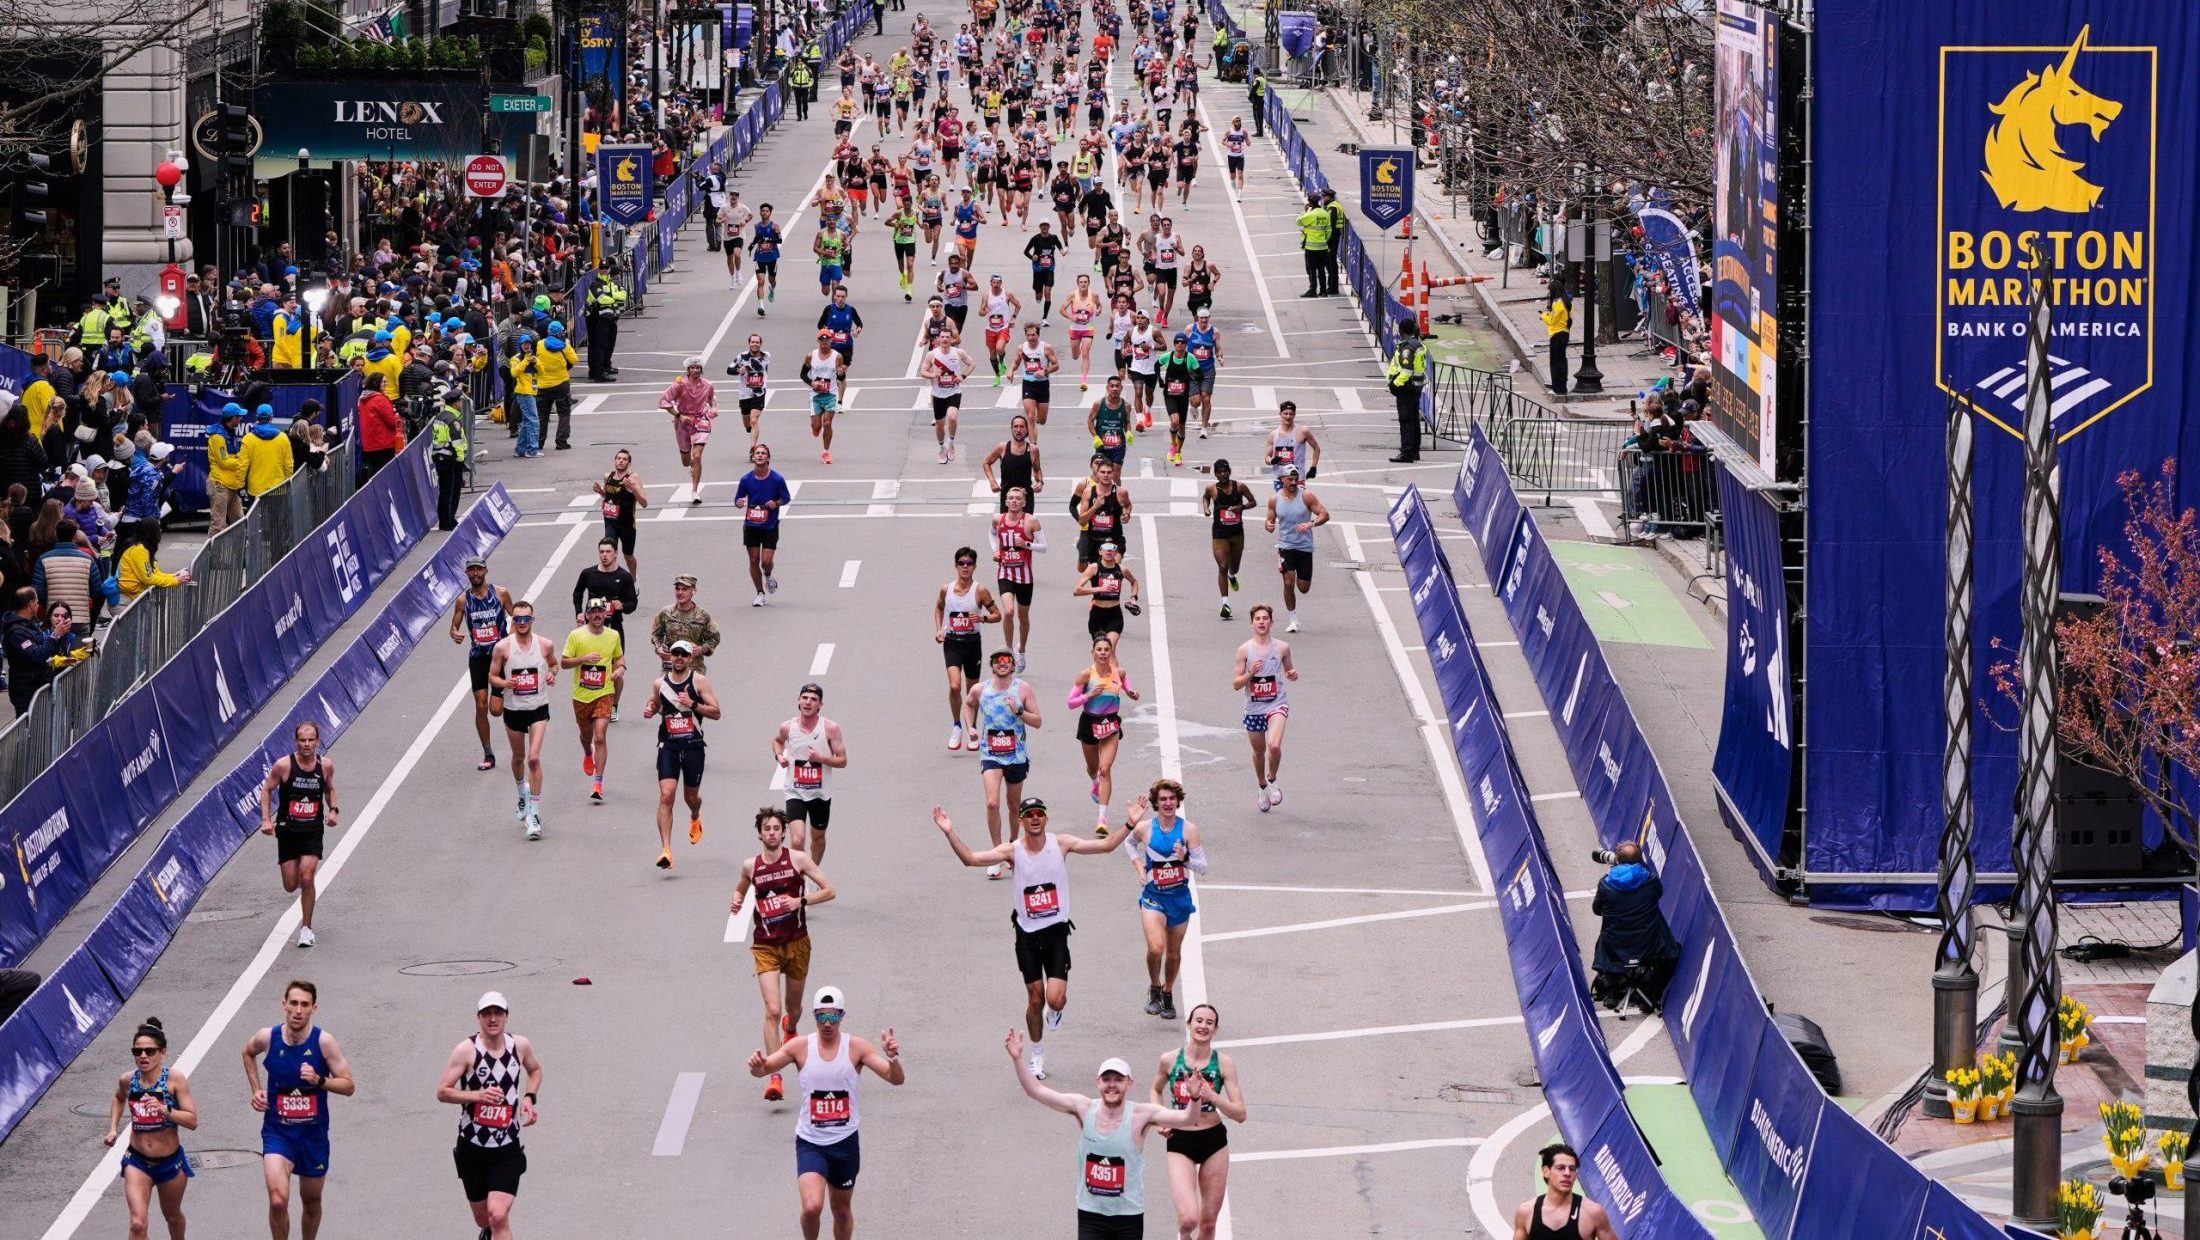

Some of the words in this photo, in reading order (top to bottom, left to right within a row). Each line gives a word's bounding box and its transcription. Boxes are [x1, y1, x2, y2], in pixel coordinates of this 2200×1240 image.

[334, 100, 444, 124] LENOX
[503, 99, 536, 111] EXETER
[366, 128, 412, 140] HOTEL
[1948, 230, 2143, 270] BOSTON
[1947, 322, 2006, 337] BANK
[583, 670, 602, 681] 3422
[1158, 868, 1180, 879] 2504
[1028, 892, 1053, 907] 5241
[283, 1096, 311, 1111] 5333
[816, 1101, 845, 1114] 6114
[479, 1105, 507, 1119] 2074
[1090, 1165, 1118, 1182] 4351
